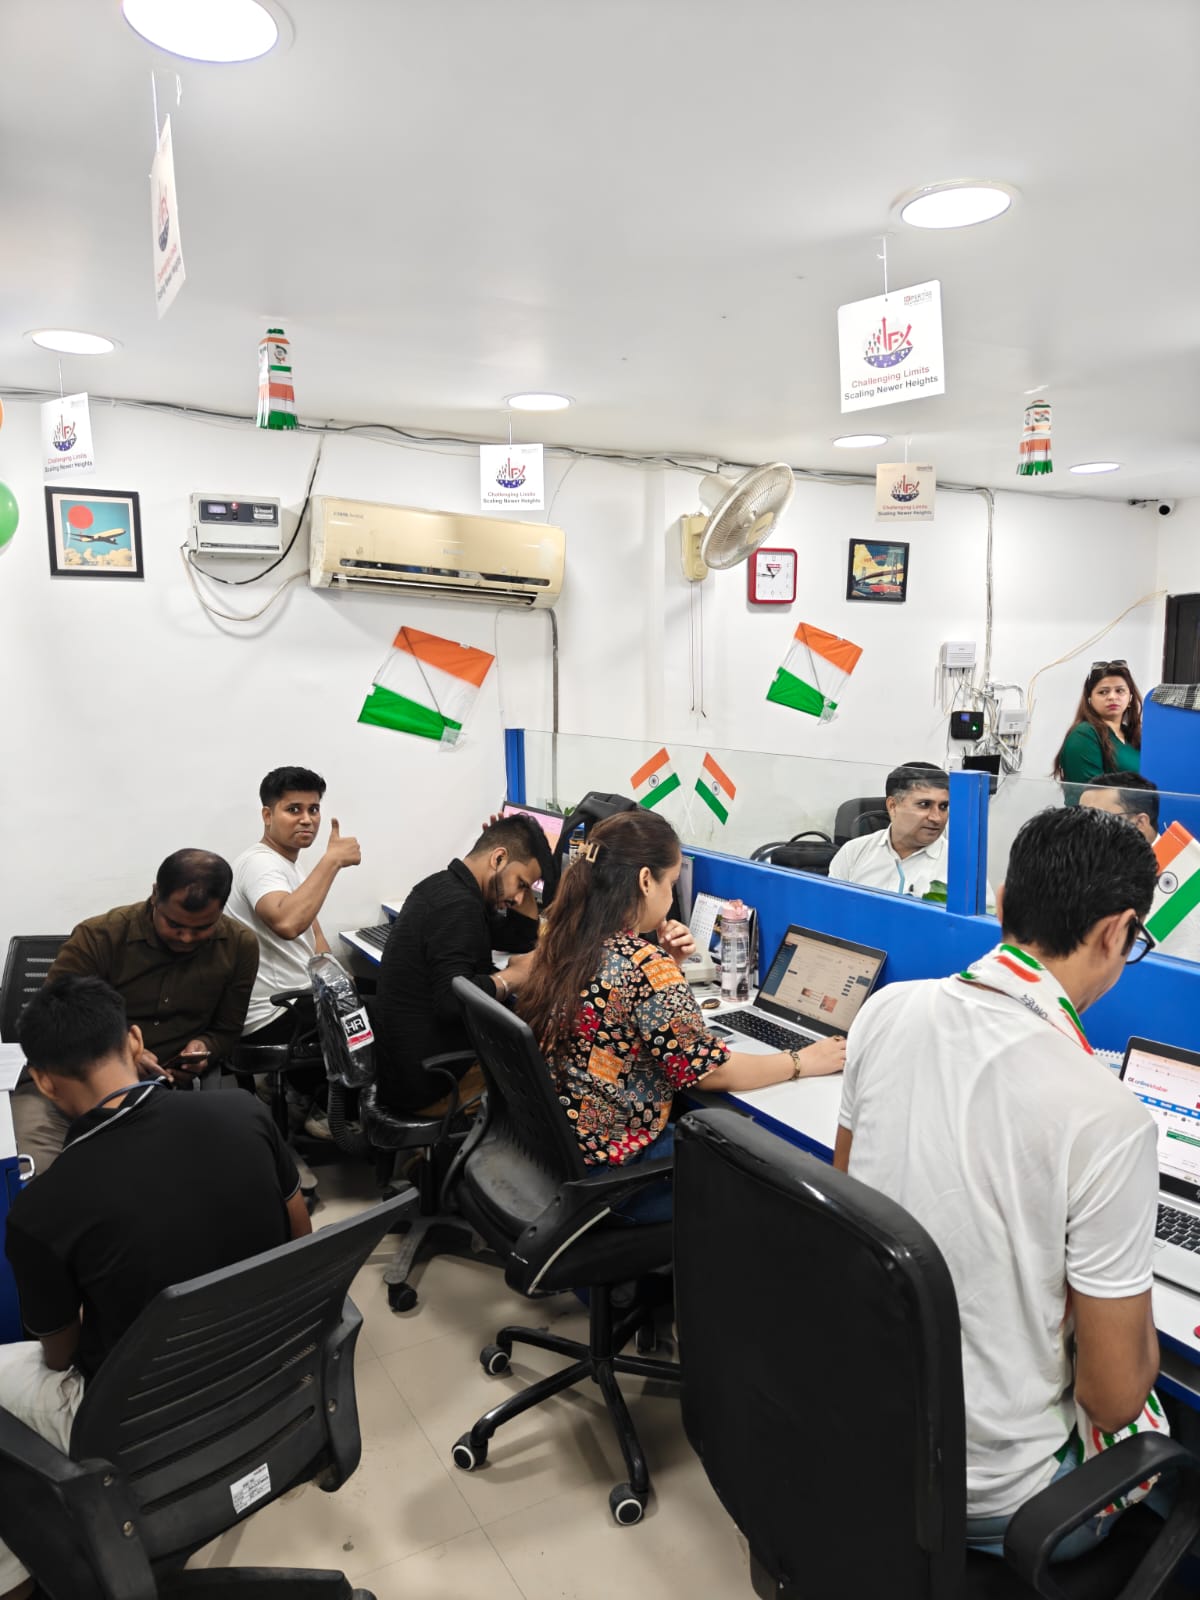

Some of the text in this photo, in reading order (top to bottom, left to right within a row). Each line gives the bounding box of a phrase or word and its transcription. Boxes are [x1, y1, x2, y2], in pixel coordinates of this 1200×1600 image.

[851, 366, 930, 388] Challenging Limits
[844, 375, 938, 401] Scaling Newer Heights
[47, 455, 73, 465] Challenging
[44, 465, 60, 473] Scaling
